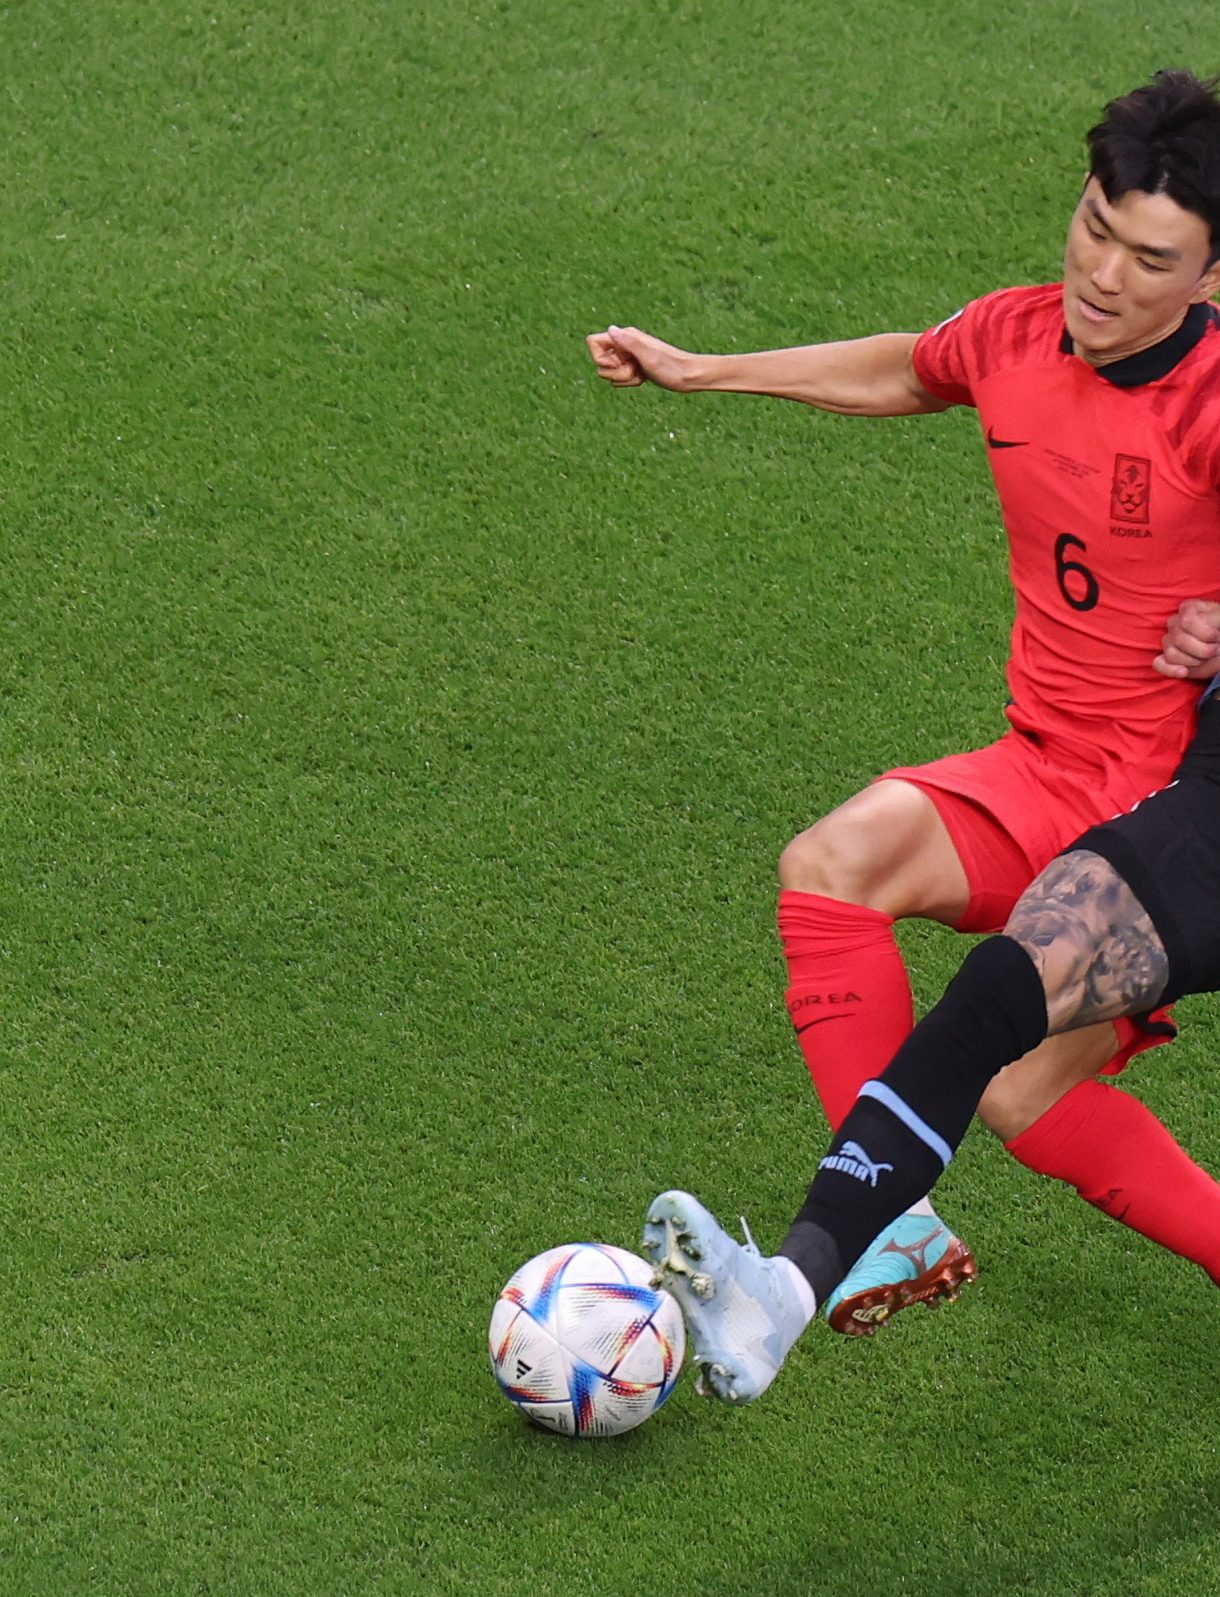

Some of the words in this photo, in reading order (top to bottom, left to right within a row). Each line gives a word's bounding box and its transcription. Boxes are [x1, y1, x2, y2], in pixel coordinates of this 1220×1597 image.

[1110, 525, 1153, 538] KOREA
[1054, 532, 1100, 612] 6
[789, 991, 863, 1012] OREA
[818, 1155, 869, 1182] PUMA
